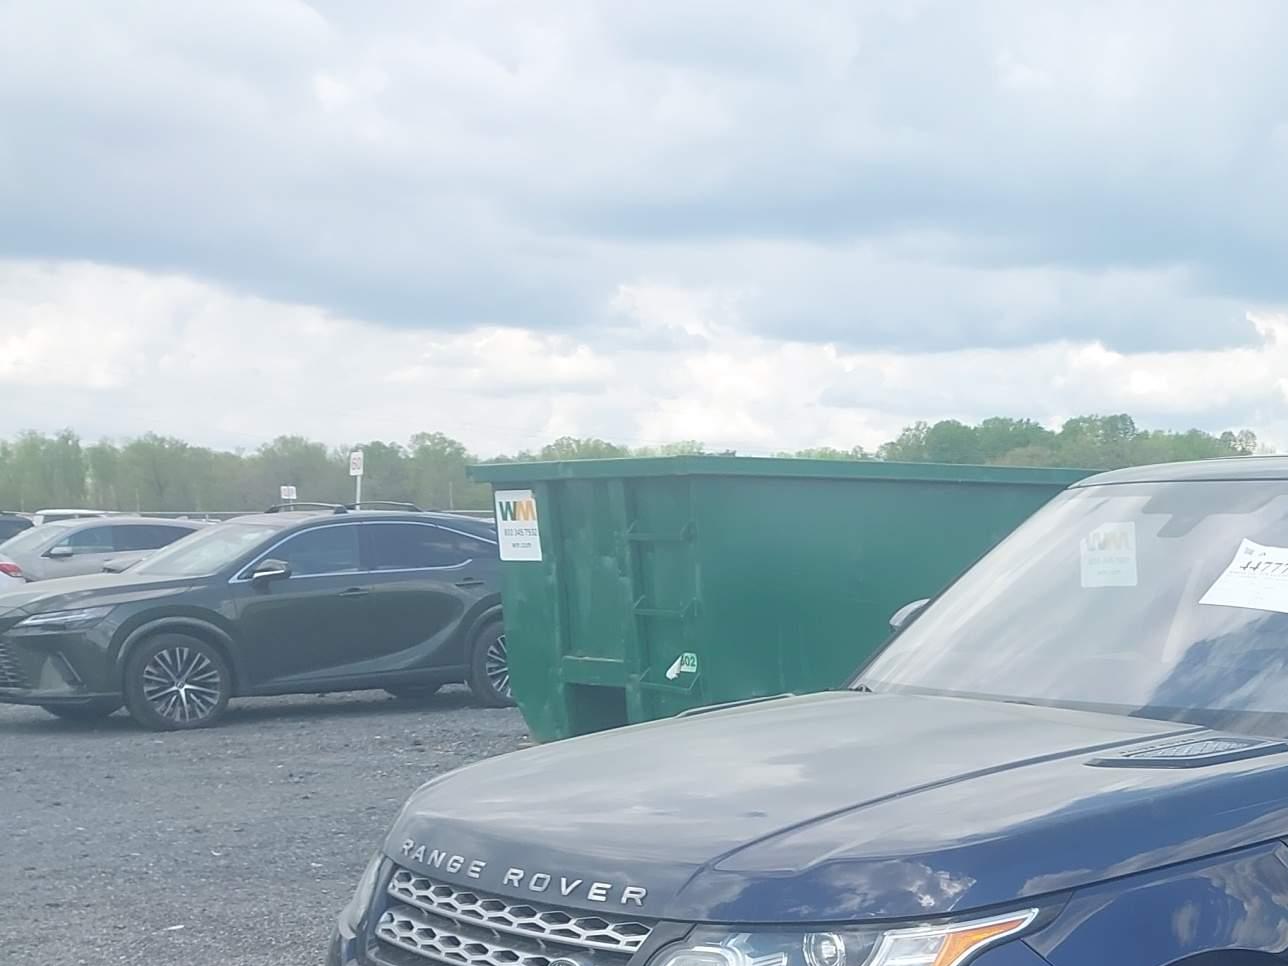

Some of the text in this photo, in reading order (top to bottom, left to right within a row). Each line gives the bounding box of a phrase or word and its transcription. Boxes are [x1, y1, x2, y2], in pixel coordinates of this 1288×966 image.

[499, 501, 536, 521] WM
[401, 839, 648, 906] RANGE ROVER
